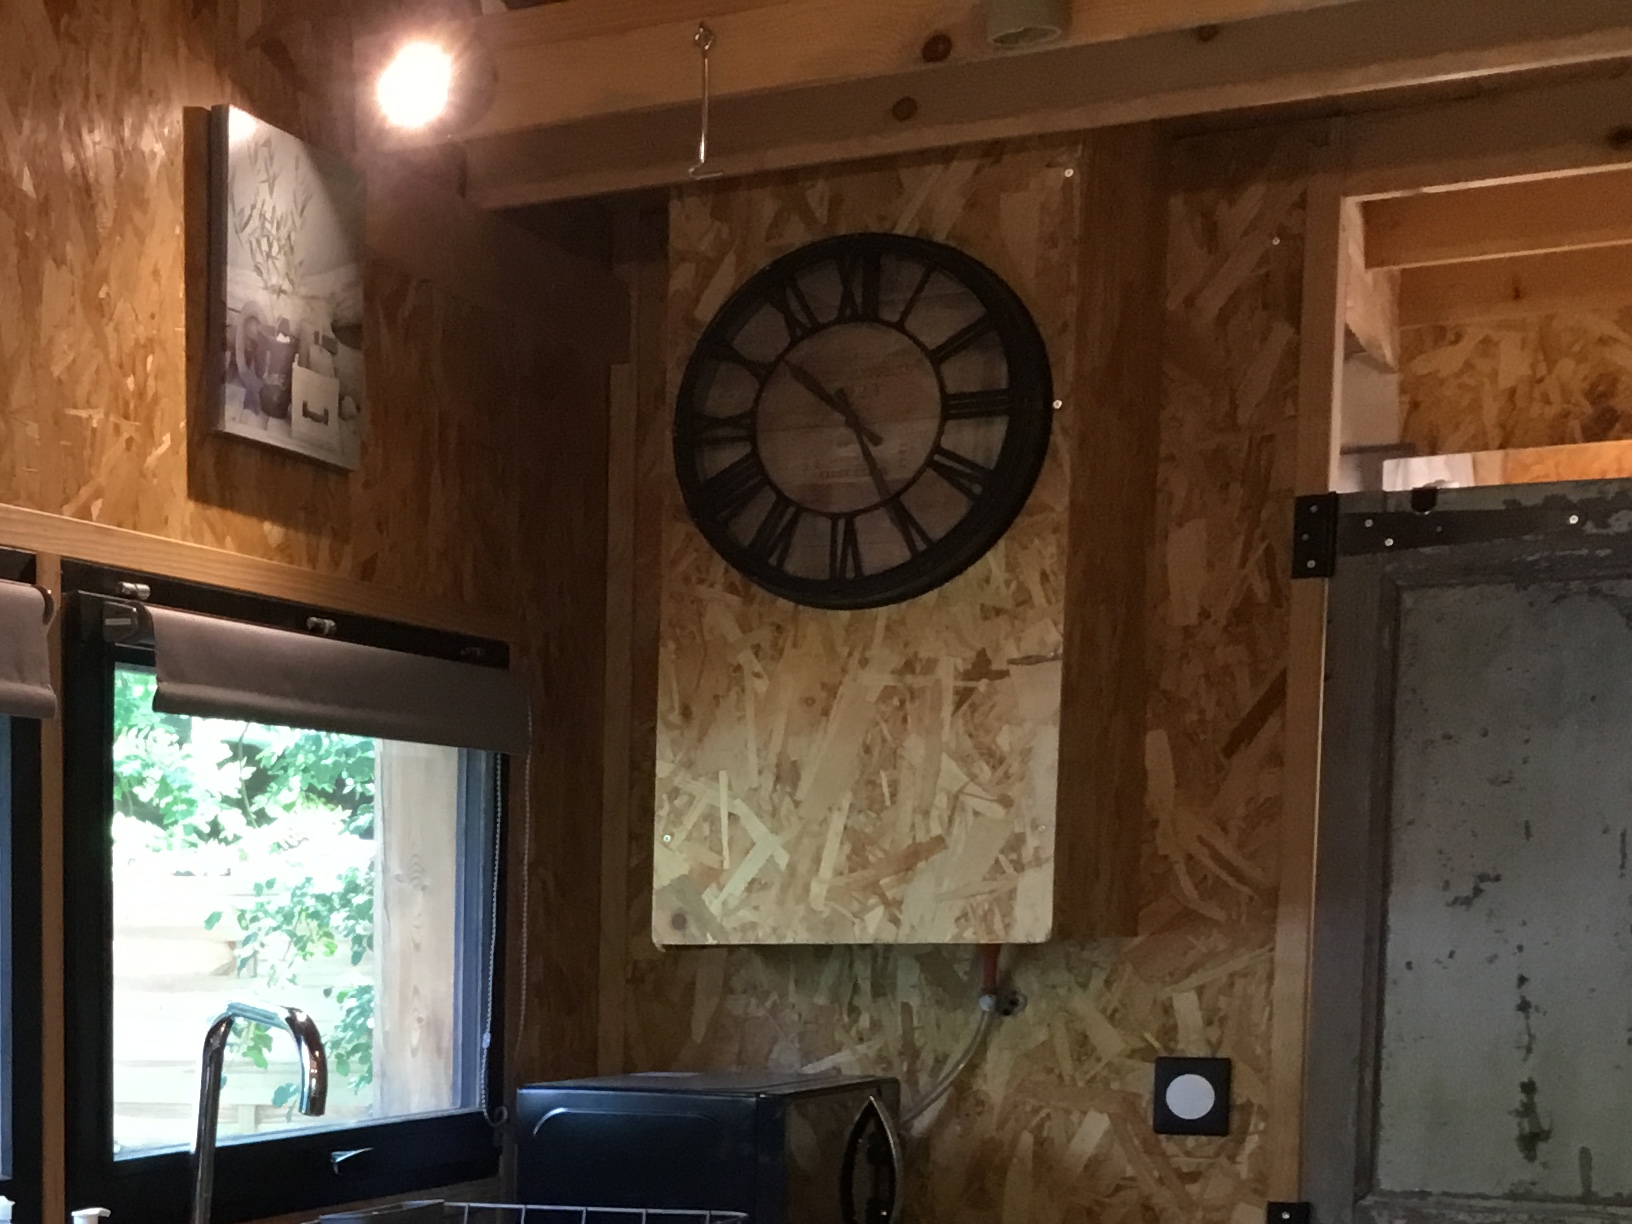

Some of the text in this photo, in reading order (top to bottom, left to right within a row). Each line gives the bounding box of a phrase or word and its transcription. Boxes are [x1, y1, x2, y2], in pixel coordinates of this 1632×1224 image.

[900, 264, 936, 324] I
[932, 314, 992, 362] II
[943, 389, 1011, 420] III
